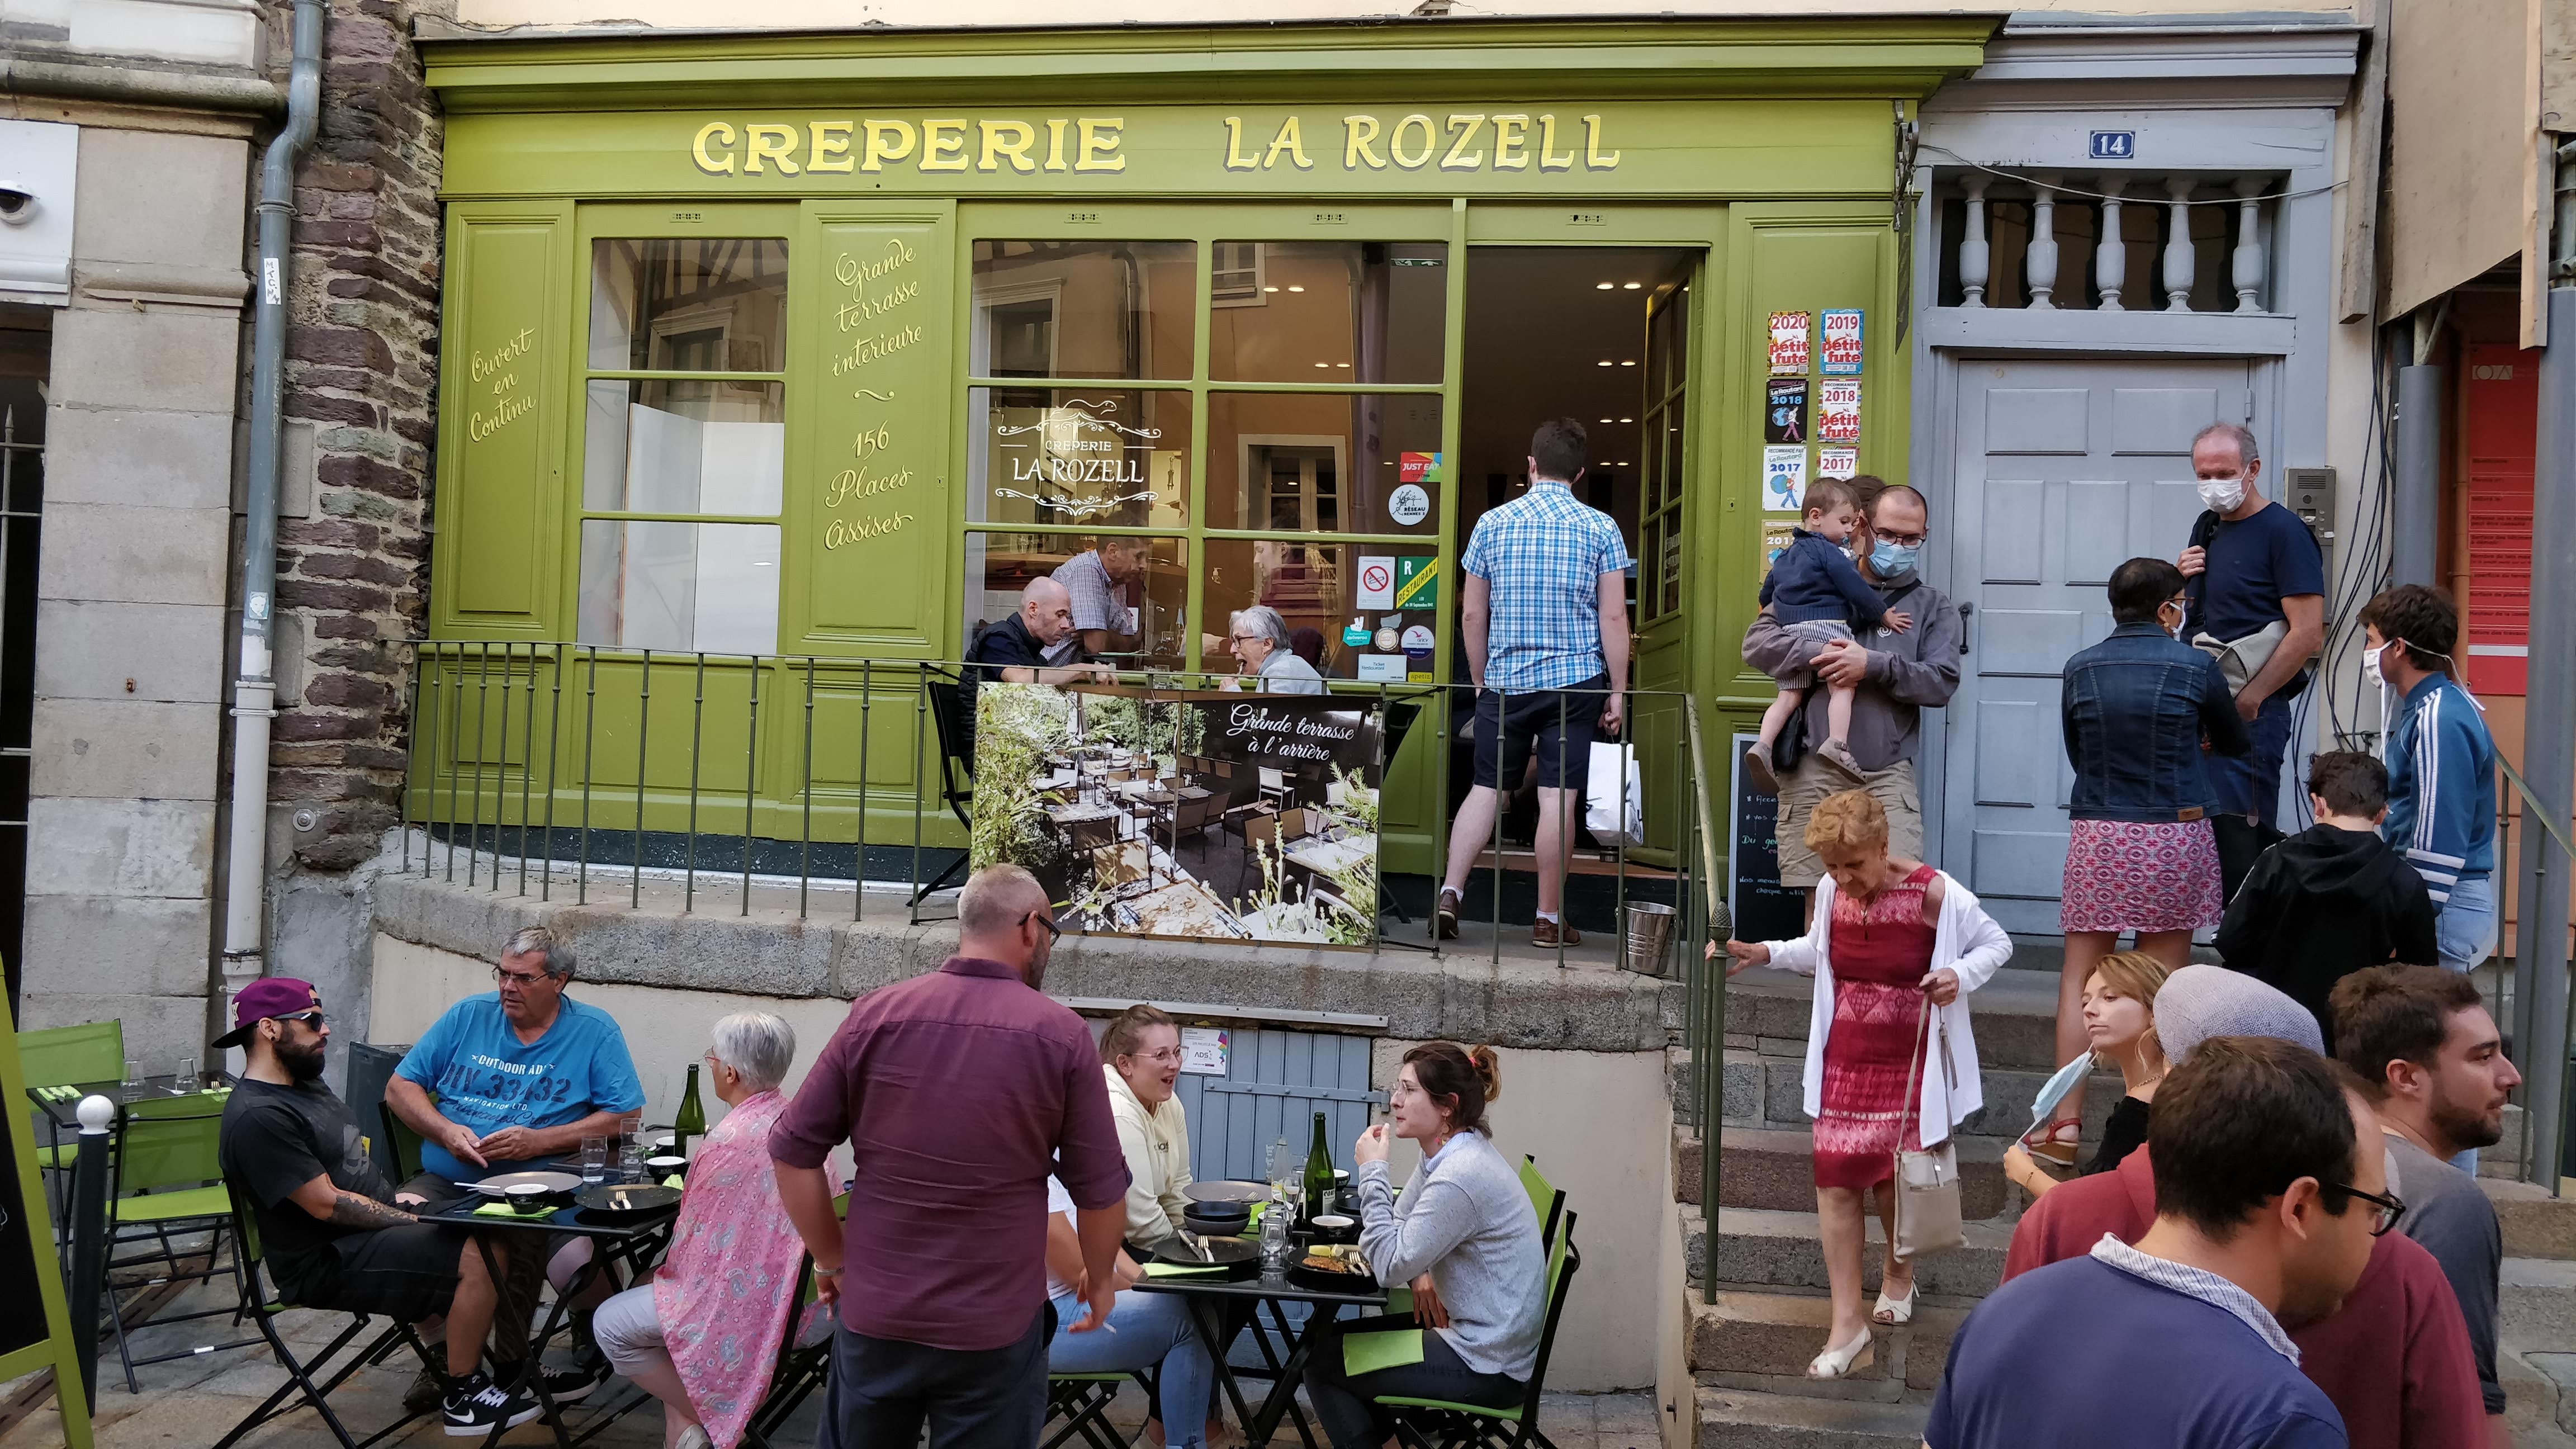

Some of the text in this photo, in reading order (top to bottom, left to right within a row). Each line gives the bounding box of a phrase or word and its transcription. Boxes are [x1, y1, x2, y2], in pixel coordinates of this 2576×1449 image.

[692, 113, 1622, 175] CREPERIE LA ROZELL
[2100, 135, 2125, 154] 14
[835, 238, 916, 302] Grande
[833, 280, 921, 333] terrasse
[1770, 315, 1808, 330] 2020
[1826, 316, 1859, 330] 2019
[471, 327, 536, 382] Ouvert
[1769, 340, 1808, 356] petit
[1821, 339, 1863, 354] petit
[491, 373, 519, 395] en
[1778, 385, 1805, 395] Routard
[1771, 396, 1802, 405] 2018
[1824, 390, 1855, 402] 2018
[469, 395, 537, 442] Continu
[1819, 414, 1860, 429] petit
[851, 419, 891, 461] 156
[1045, 440, 1112, 451] CREPERIE
[1012, 457, 1144, 483] LA ROZELL
[1402, 463, 1423, 471] JUST
[1769, 463, 1801, 472] 2017
[1822, 458, 1854, 470] 2017
[824, 465, 914, 508] Places
[824, 510, 914, 550] Assises
[1404, 560, 1412, 575] R
[1398, 561, 1437, 603] RESTAURANT
[1226, 703, 1355, 741] Grande terrasse
[1247, 736, 1260, 752] à
[1756, 794, 1777, 806] Acce
[478, 1054, 526, 1075] OUTDOOR
[463, 1096, 510, 1110] NAVIGATION
